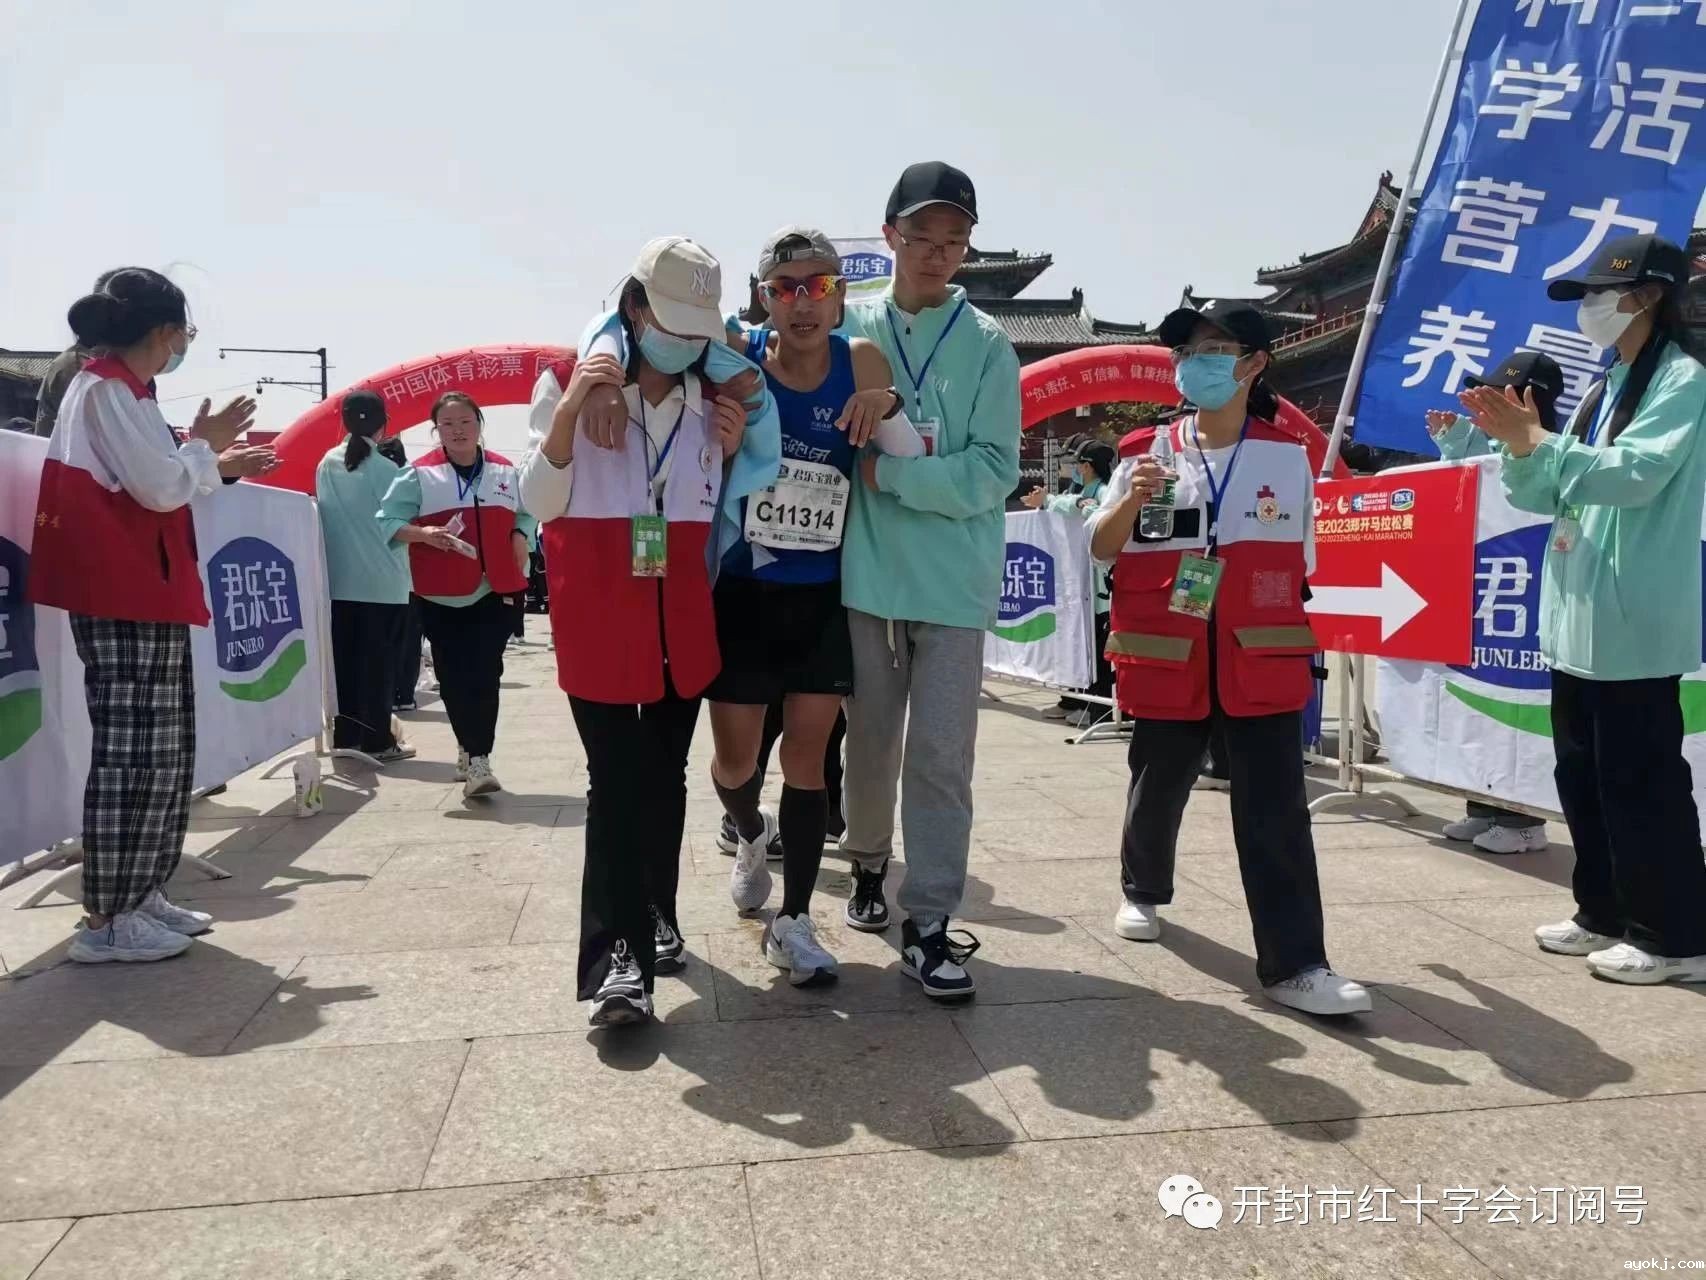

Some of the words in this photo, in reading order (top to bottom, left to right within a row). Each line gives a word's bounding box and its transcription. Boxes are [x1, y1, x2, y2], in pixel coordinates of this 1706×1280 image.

[1514, 0, 1706, 415] 活力量
[690, 268, 712, 296] NY
[840, 257, 886, 275] 君乐宝
[383, 354, 523, 403] 中国体育彩票
[756, 501, 834, 530] C11314
[1313, 514, 1414, 534] 宝2023郑开马拉松赛
[1000, 556, 1046, 599] 乐宝
[221, 561, 292, 632] 君乐宝
[1474, 557, 1541, 637] 君
[1471, 646, 1551, 672] JUNLEB
